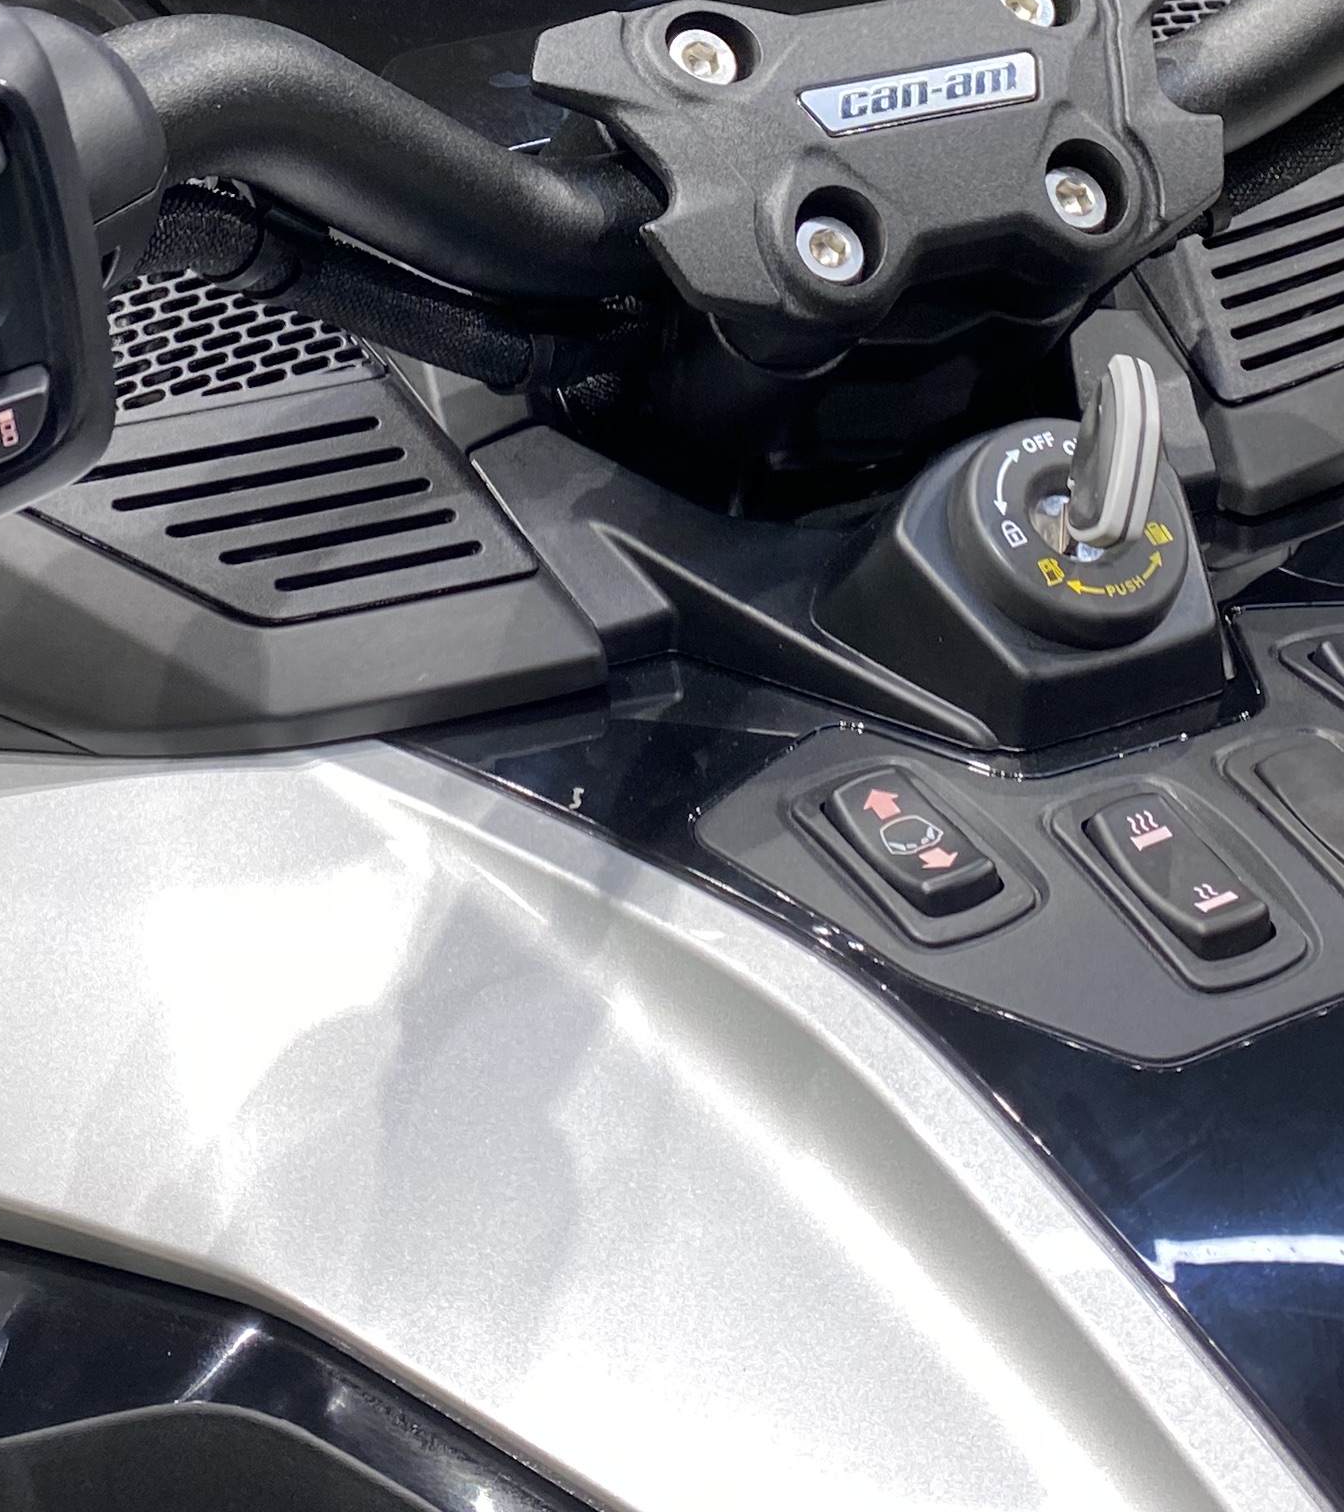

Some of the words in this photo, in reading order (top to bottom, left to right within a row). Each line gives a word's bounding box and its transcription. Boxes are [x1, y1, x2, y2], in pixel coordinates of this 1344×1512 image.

[840, 62, 1017, 119] can-am
[1022, 431, 1055, 454] OFF
[1062, 437, 1078, 456] O
[1105, 575, 1146, 598] PUSH
